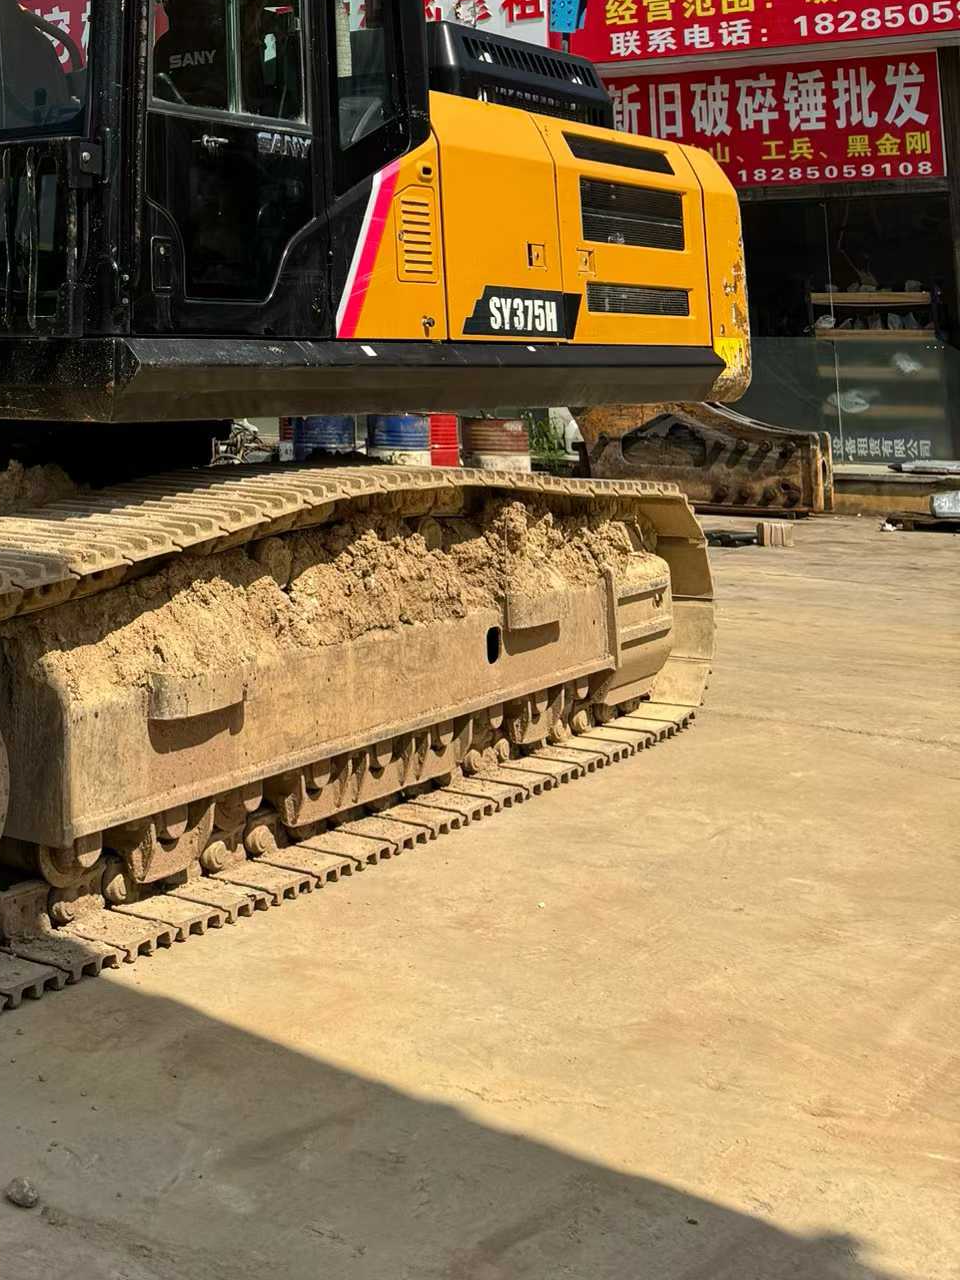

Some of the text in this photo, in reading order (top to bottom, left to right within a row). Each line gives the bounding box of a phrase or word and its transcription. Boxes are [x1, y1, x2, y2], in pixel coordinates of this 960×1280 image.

[610, 0, 960, 57] 联系电话： 1828505
[168, 49, 217, 69] SANY
[608, 62, 929, 138] 新旧破碎锤批发
[708, 130, 930, 164] 山、工兵、黑金刚
[738, 161, 933, 182] 18285059108
[489, 296, 557, 332] SY375H
[832, 436, 931, 458] 设备租赁有限公司
